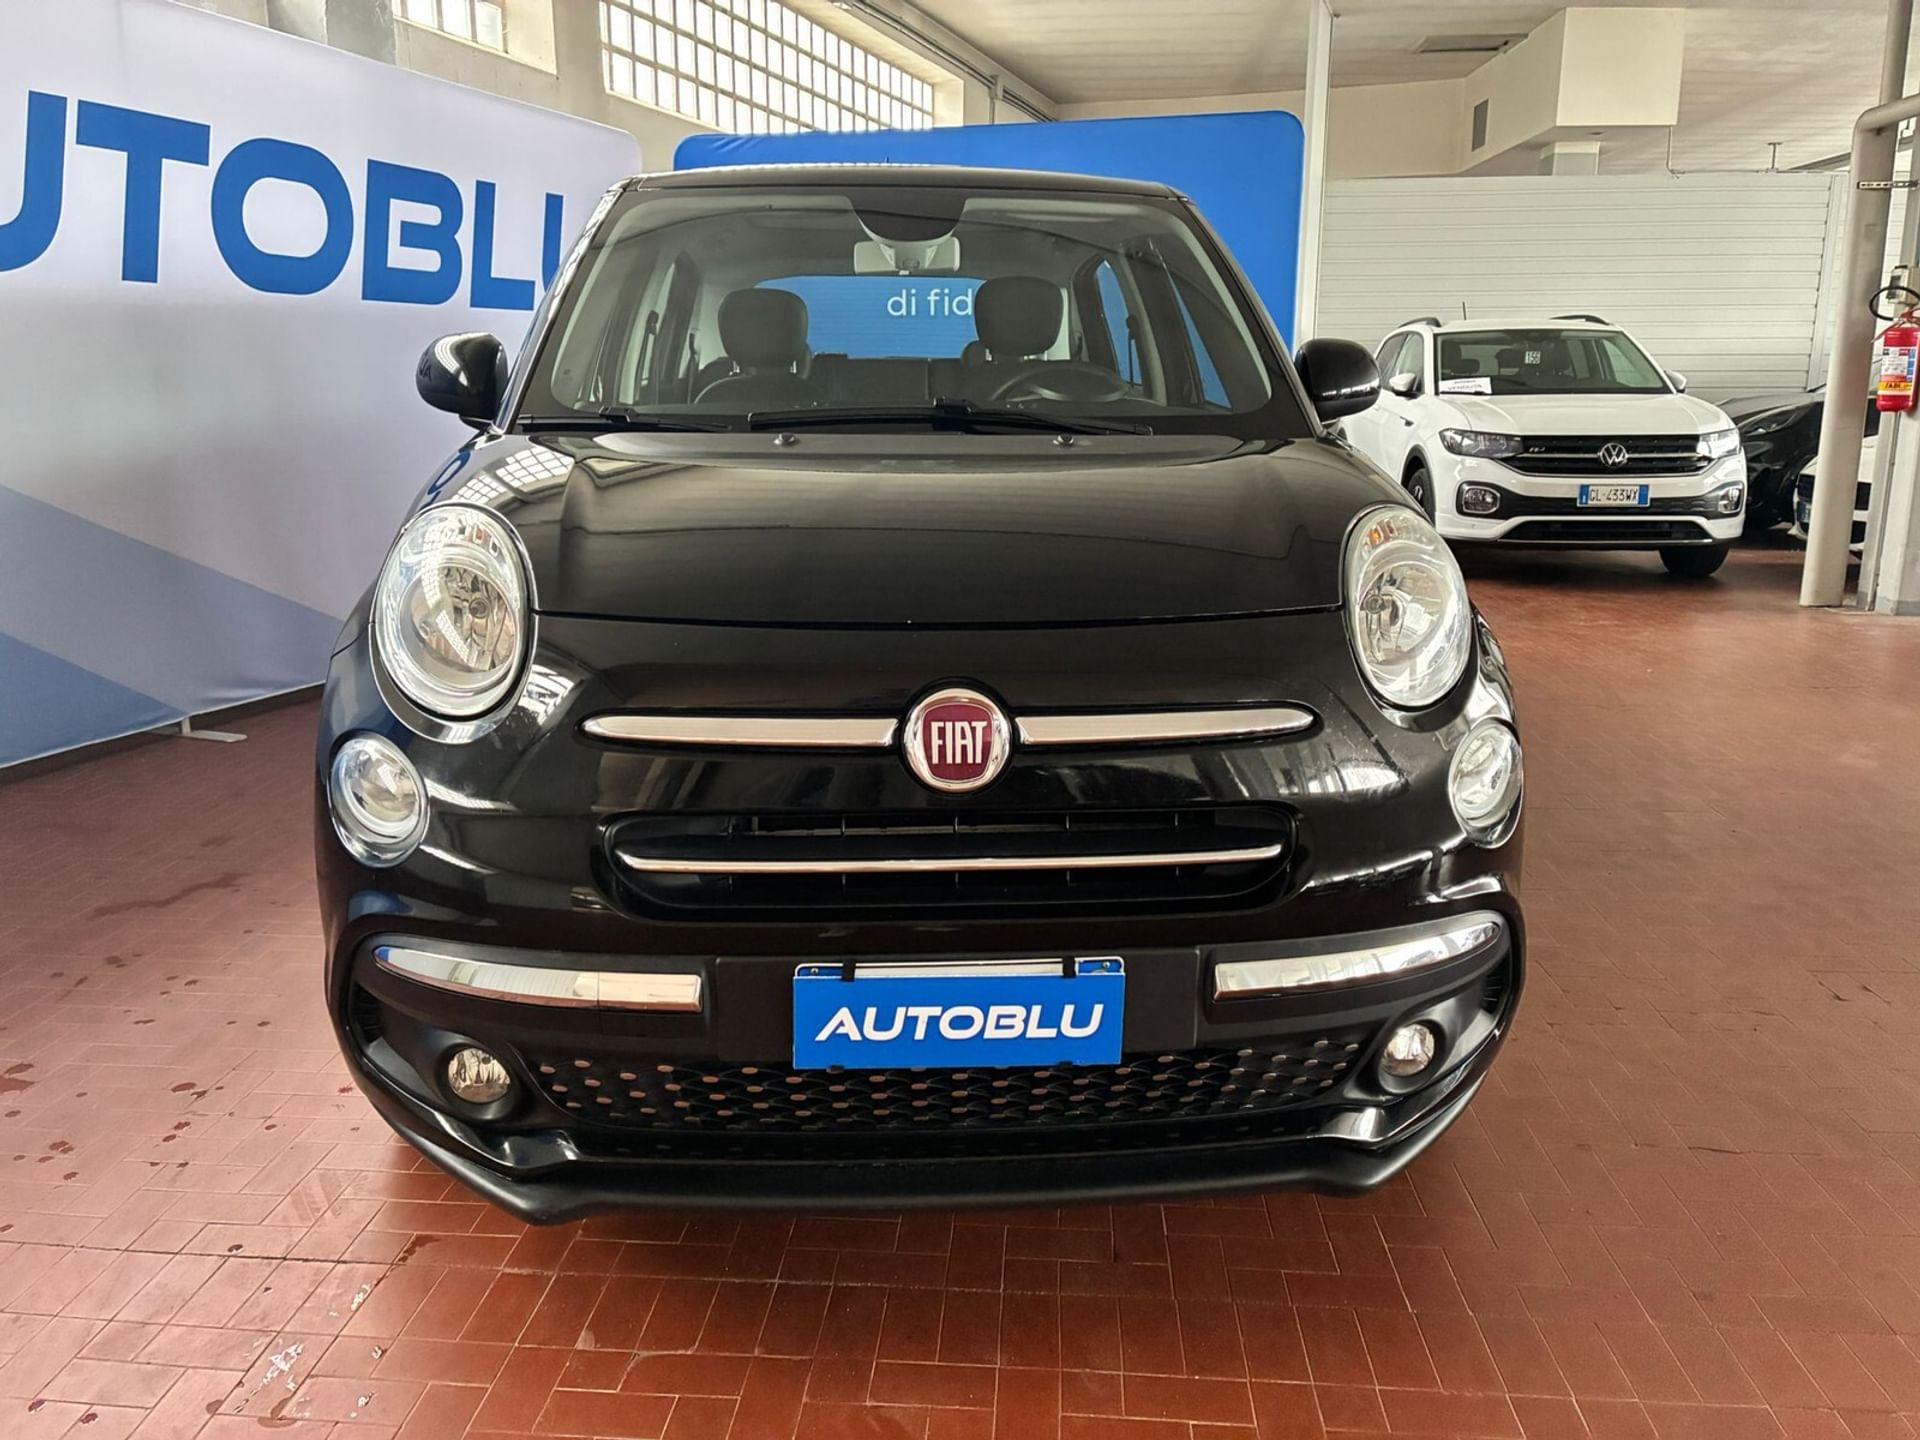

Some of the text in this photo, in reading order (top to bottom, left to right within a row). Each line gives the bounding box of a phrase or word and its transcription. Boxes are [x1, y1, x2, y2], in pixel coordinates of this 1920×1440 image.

[886, 288, 973, 316] di fid
[930, 720, 988, 765] FIAT
[813, 1003, 1104, 1041] AUTOBLU
